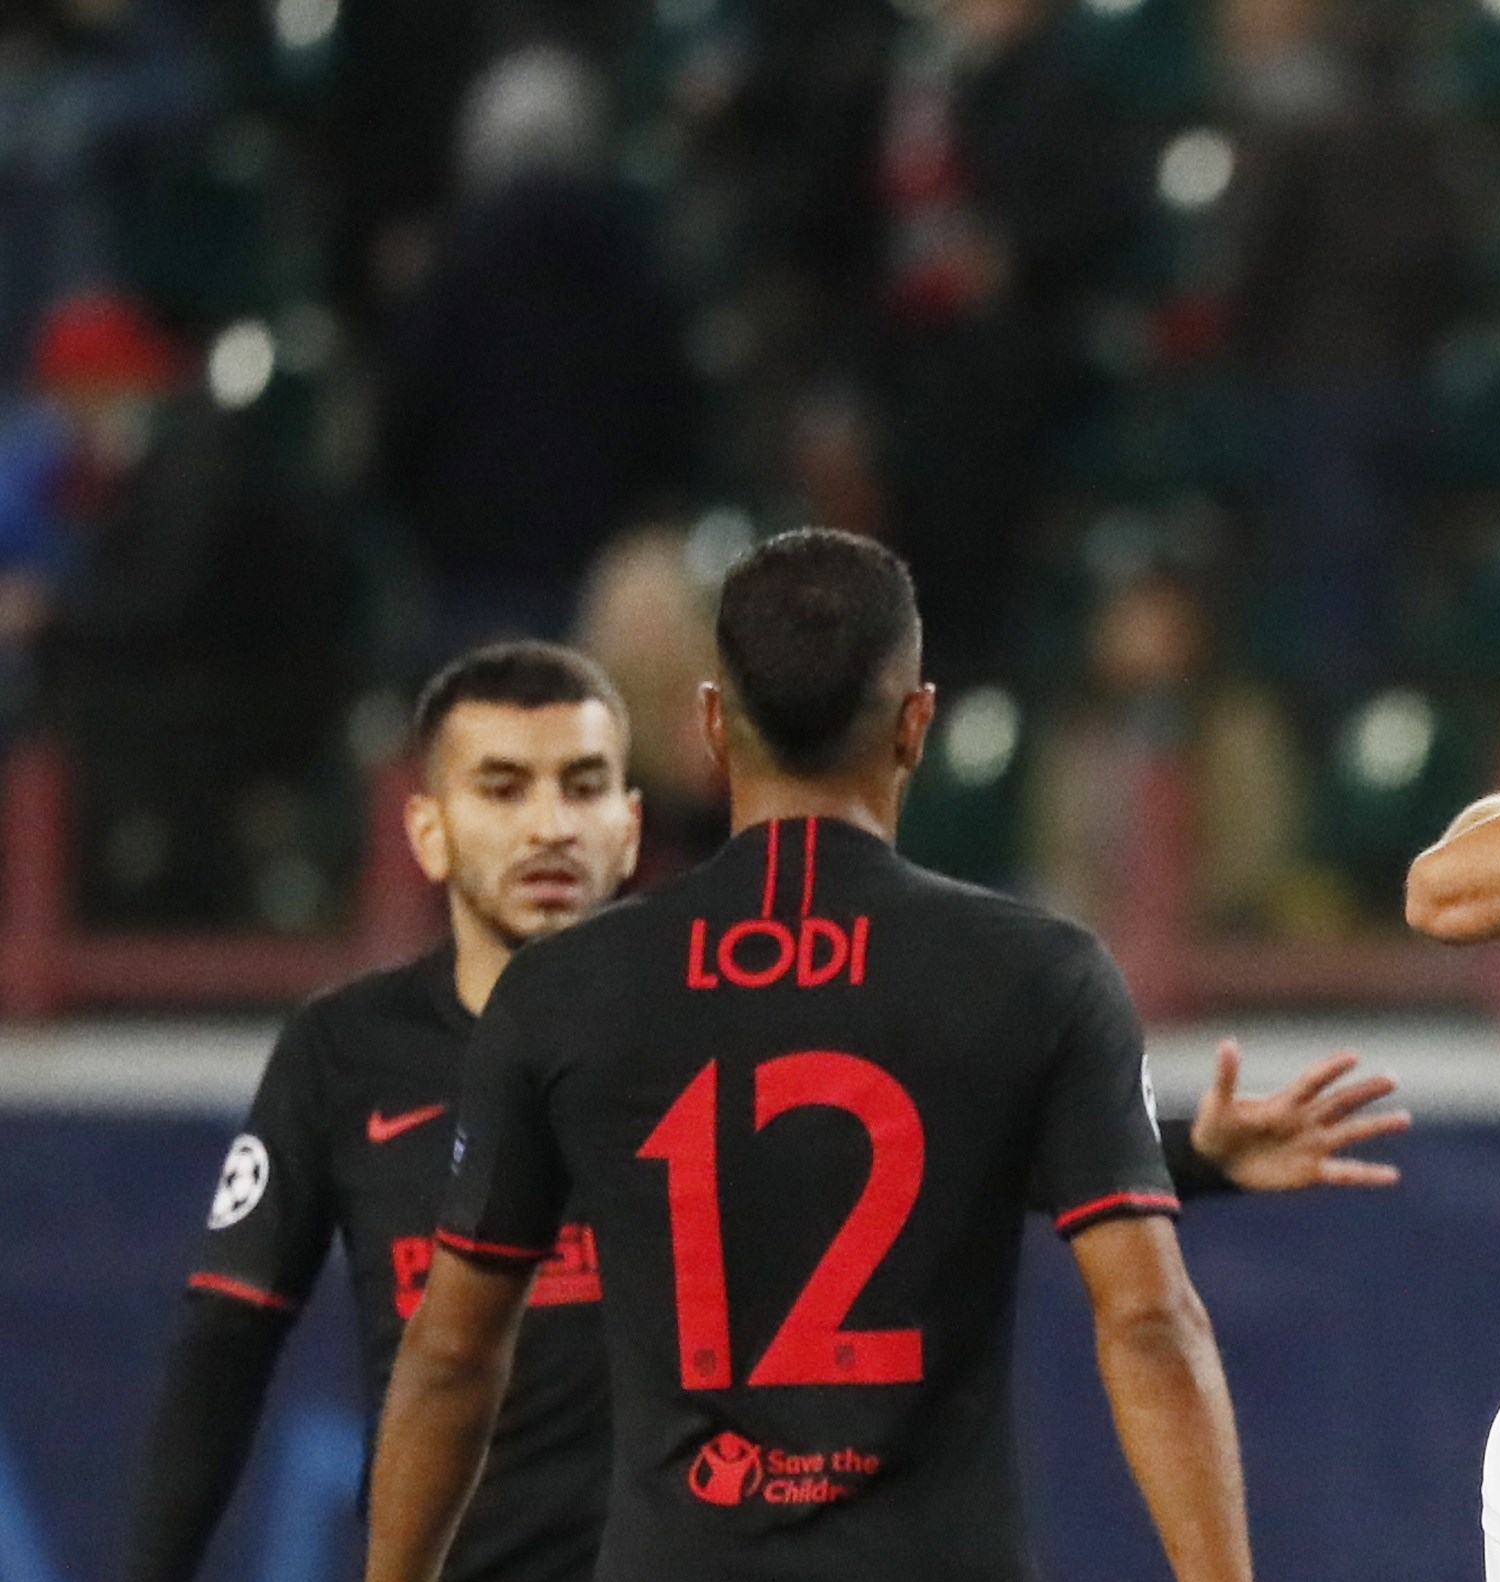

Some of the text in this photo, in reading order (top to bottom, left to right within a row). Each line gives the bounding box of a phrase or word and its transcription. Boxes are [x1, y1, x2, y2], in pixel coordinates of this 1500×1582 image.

[687, 915, 869, 989] LODI
[635, 1050, 925, 1391] 12
[765, 1446, 881, 1475] Save the
